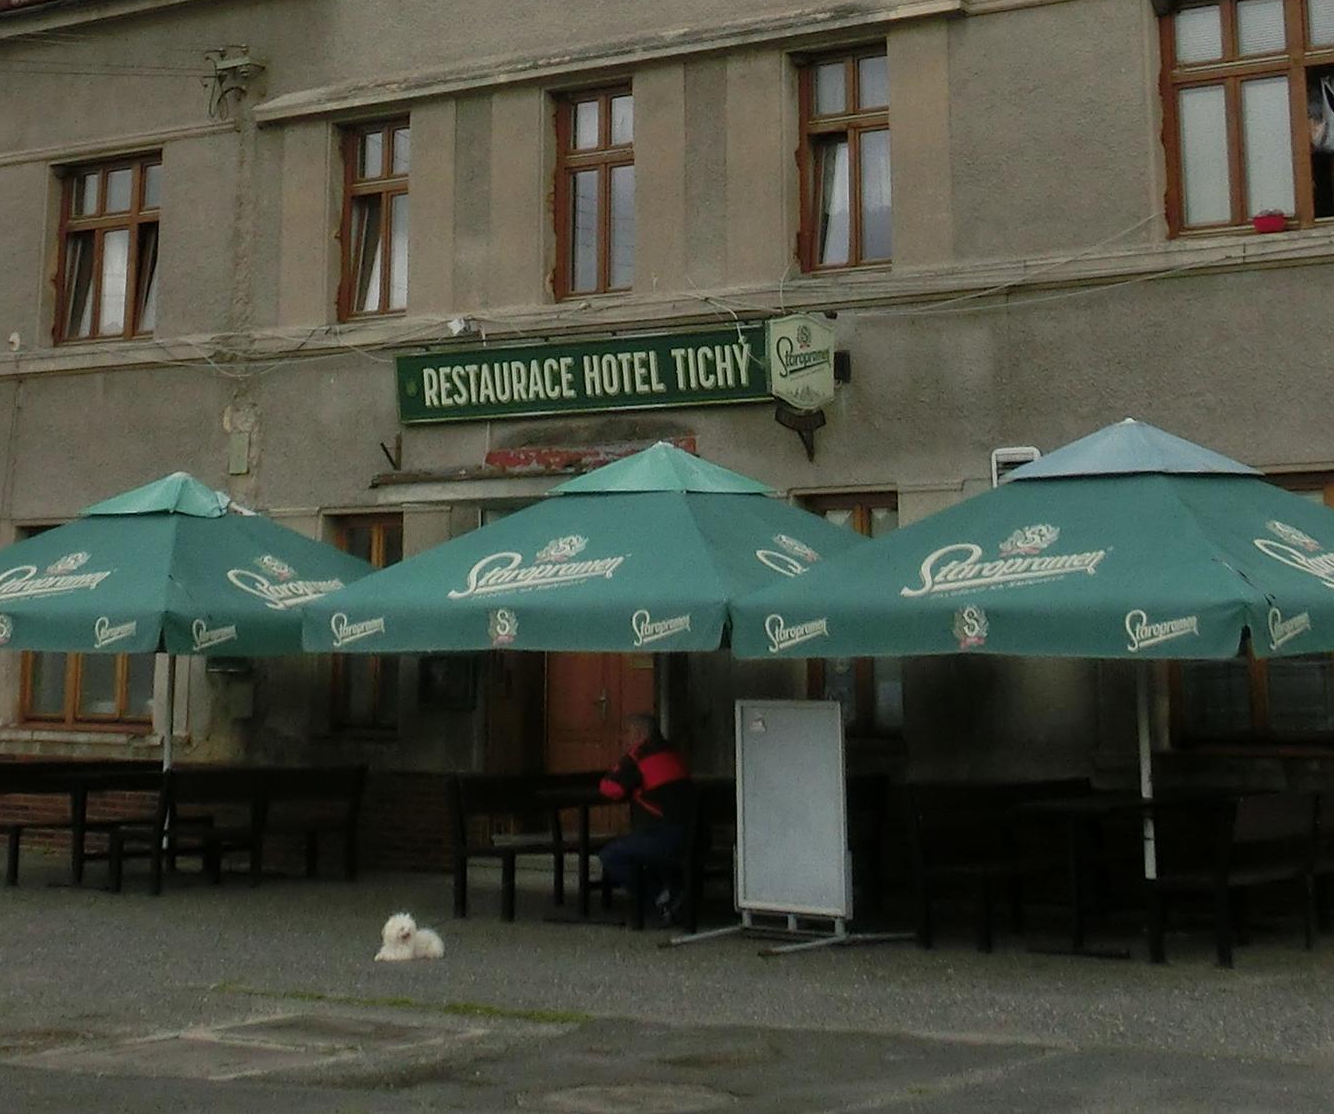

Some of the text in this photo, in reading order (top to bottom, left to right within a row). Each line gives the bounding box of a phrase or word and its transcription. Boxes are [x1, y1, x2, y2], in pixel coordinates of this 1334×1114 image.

[776, 336, 831, 377] Staropramen
[423, 357, 576, 407] RESTAURACE
[583, 350, 666, 397] HOTEL
[448, 552, 624, 599] Staropramen
[901, 543, 1105, 597] Staropramen
[331, 612, 385, 646] Staropramen
[632, 609, 691, 646] Staropramen
[765, 614, 829, 652] Staropramen
[1125, 609, 1199, 652] Staropramen
